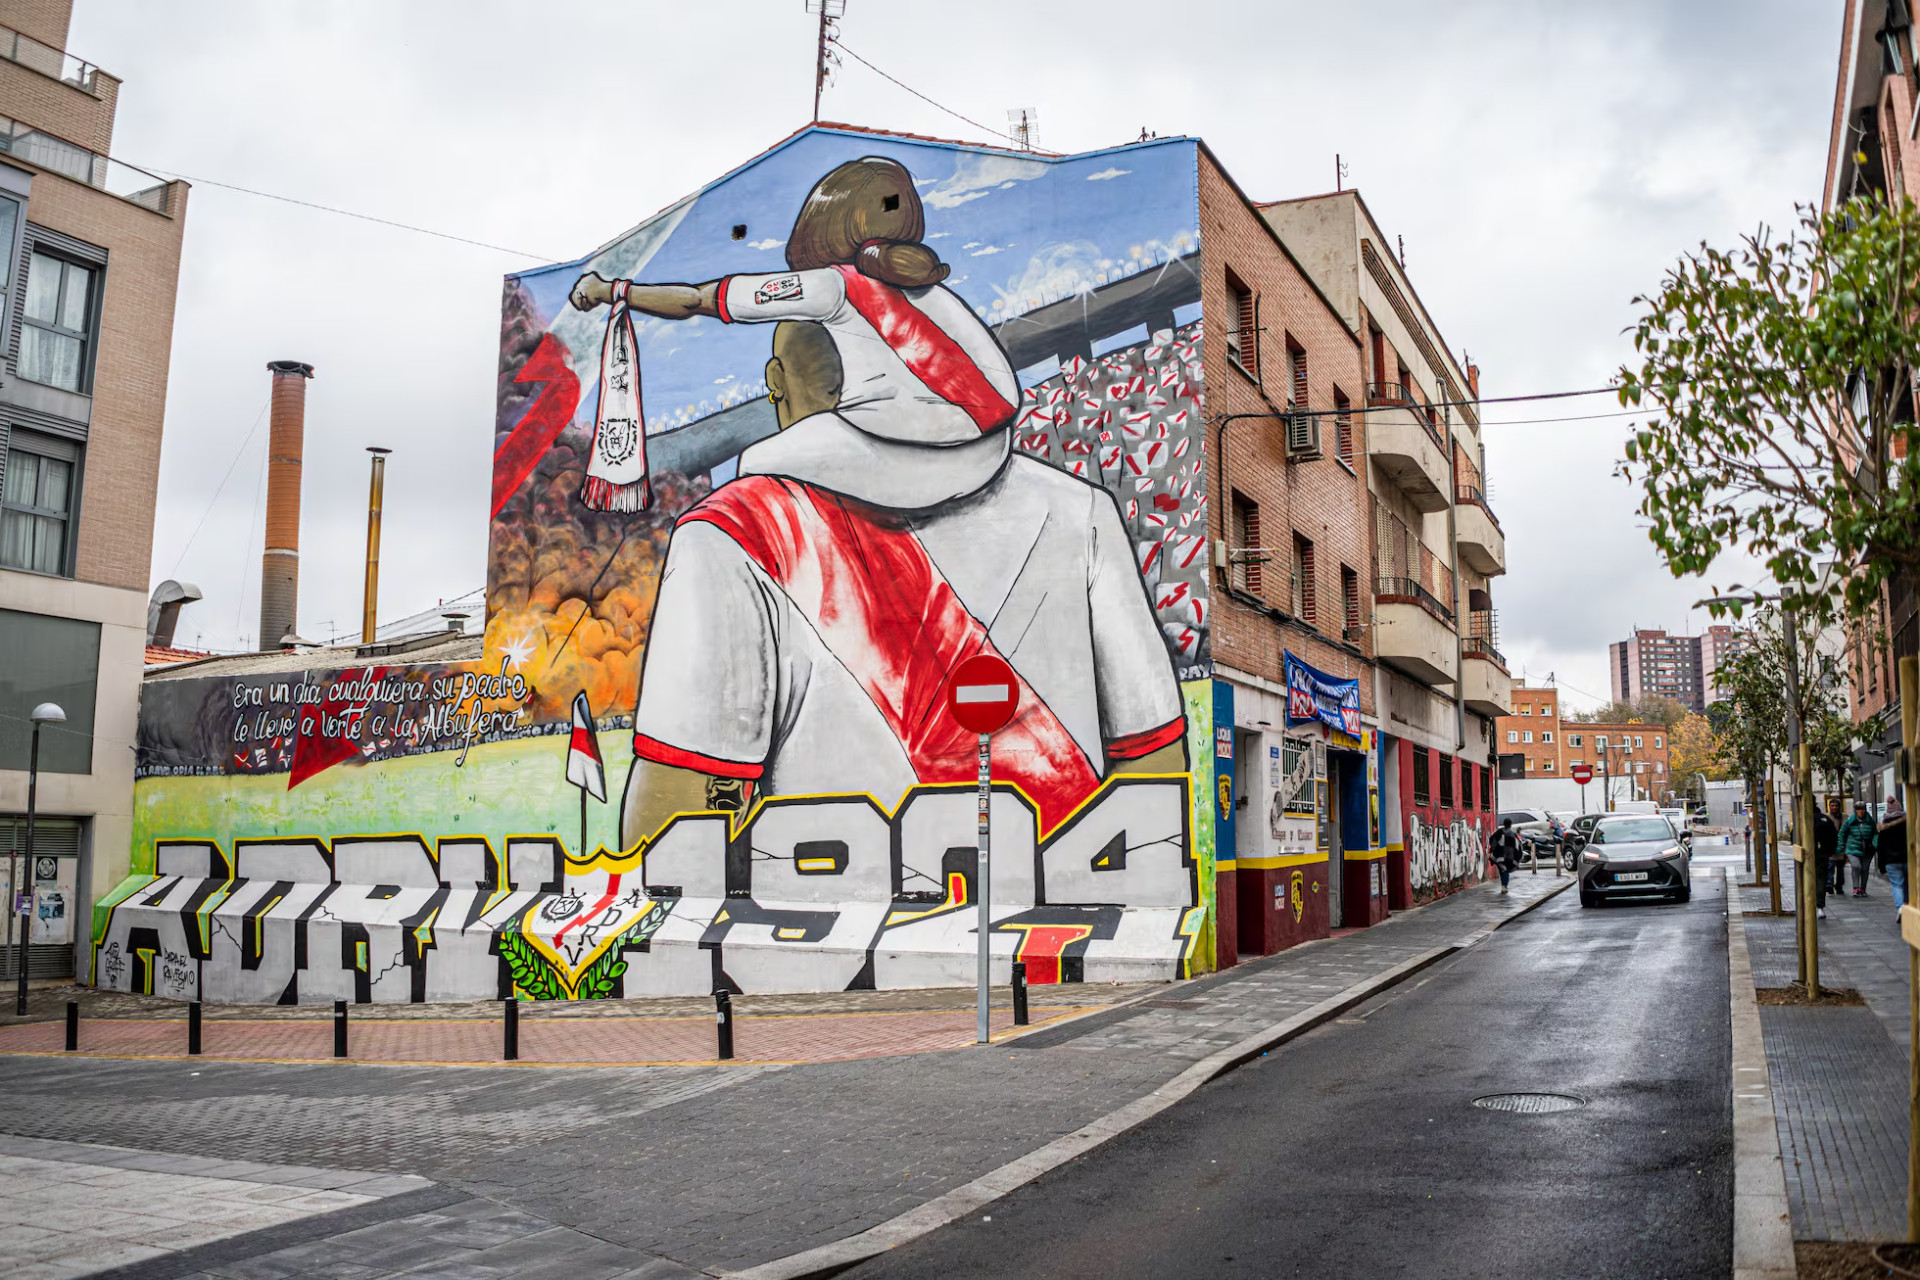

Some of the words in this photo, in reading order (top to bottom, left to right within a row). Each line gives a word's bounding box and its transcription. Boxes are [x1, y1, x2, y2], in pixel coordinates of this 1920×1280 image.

[233, 683, 263, 708] Era
[270, 682, 290, 704] un
[294, 670, 322, 704] día
[432, 677, 455, 700] su
[450, 655, 528, 717] padre
[234, 713, 249, 742] le
[254, 709, 297, 740] llevó
[301, 716, 316, 737] a
[372, 715, 387, 737] a
[394, 704, 415, 738] la
[597, 716, 632, 732] RAYO
